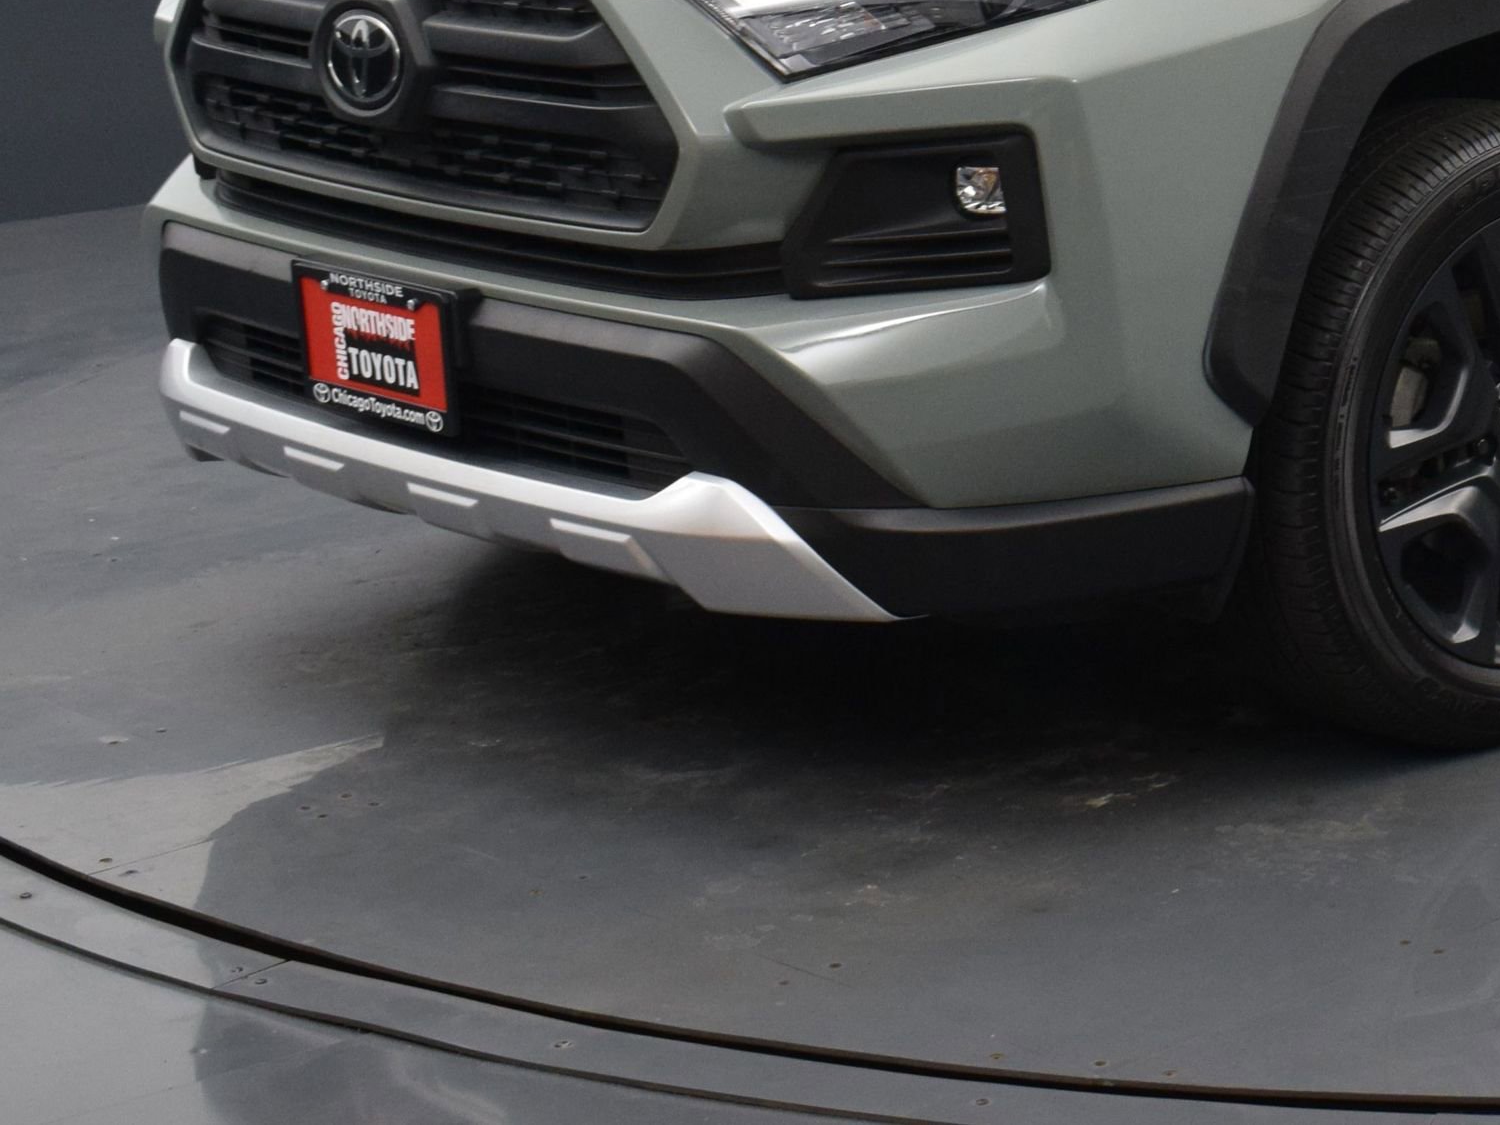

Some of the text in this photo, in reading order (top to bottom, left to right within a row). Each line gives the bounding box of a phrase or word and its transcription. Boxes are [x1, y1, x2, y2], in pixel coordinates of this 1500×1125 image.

[329, 273, 404, 297] NORTHSIDE
[349, 287, 388, 304] TOYOTA
[331, 301, 350, 380] CHICAGO
[340, 304, 416, 342] NORTHSIDE
[348, 346, 420, 390] TOYOTA
[331, 387, 426, 426] ChicagoToyota.com
